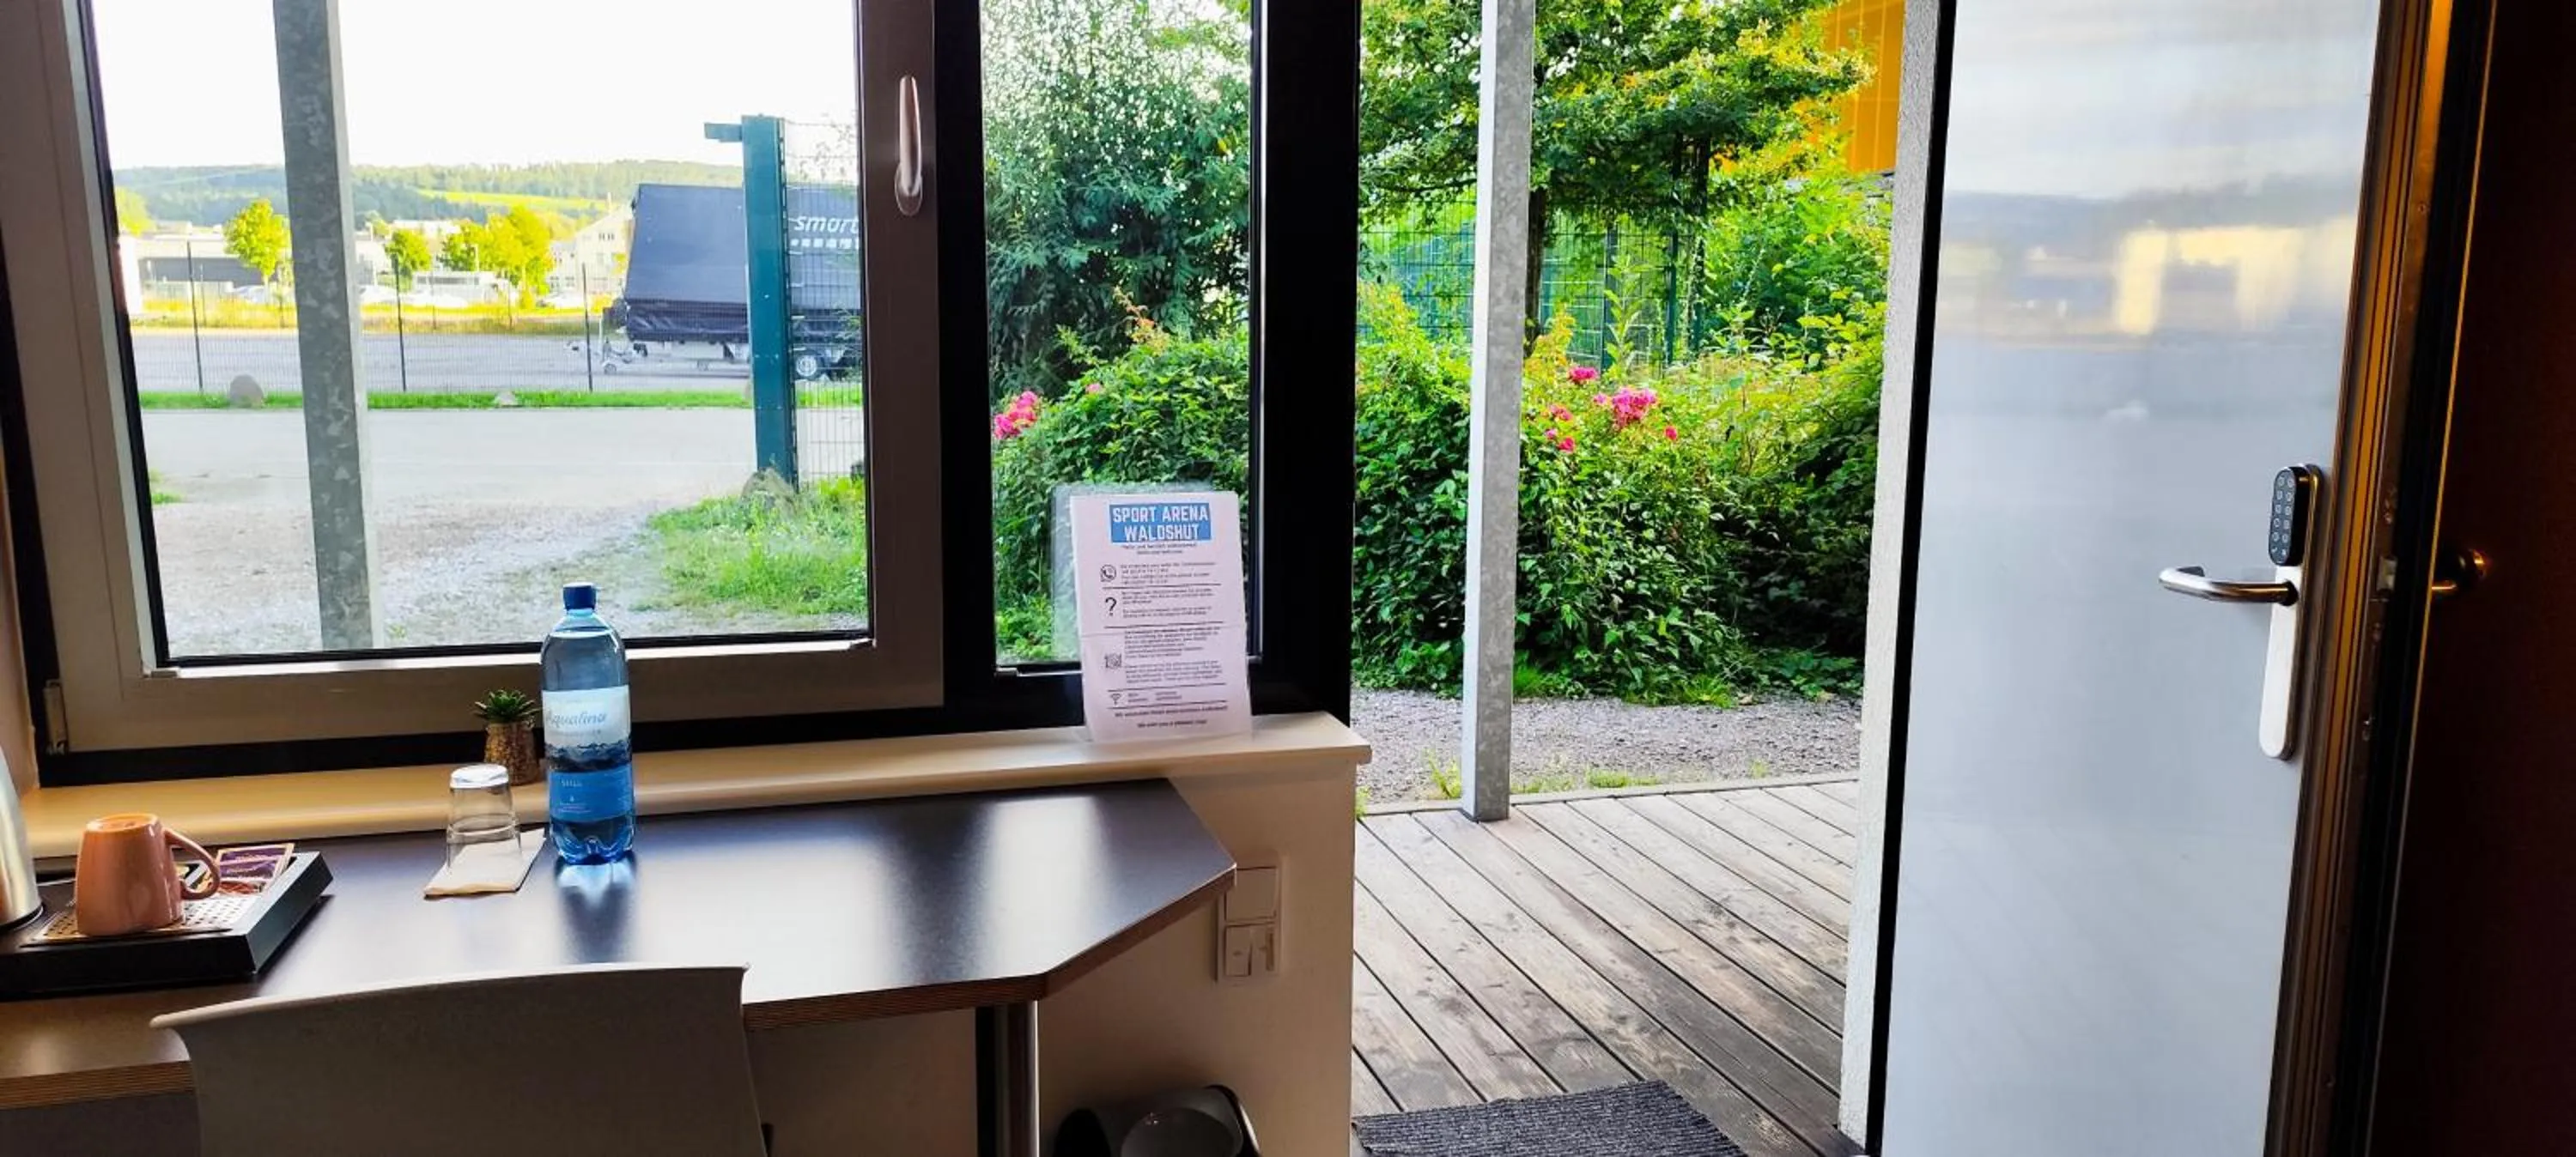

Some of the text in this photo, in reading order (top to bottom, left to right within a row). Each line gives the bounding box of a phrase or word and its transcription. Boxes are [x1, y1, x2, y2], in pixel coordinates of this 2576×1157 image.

[1112, 505, 1208, 523] SPORT ARENA
[1124, 524, 1200, 542] WALDSHUT
